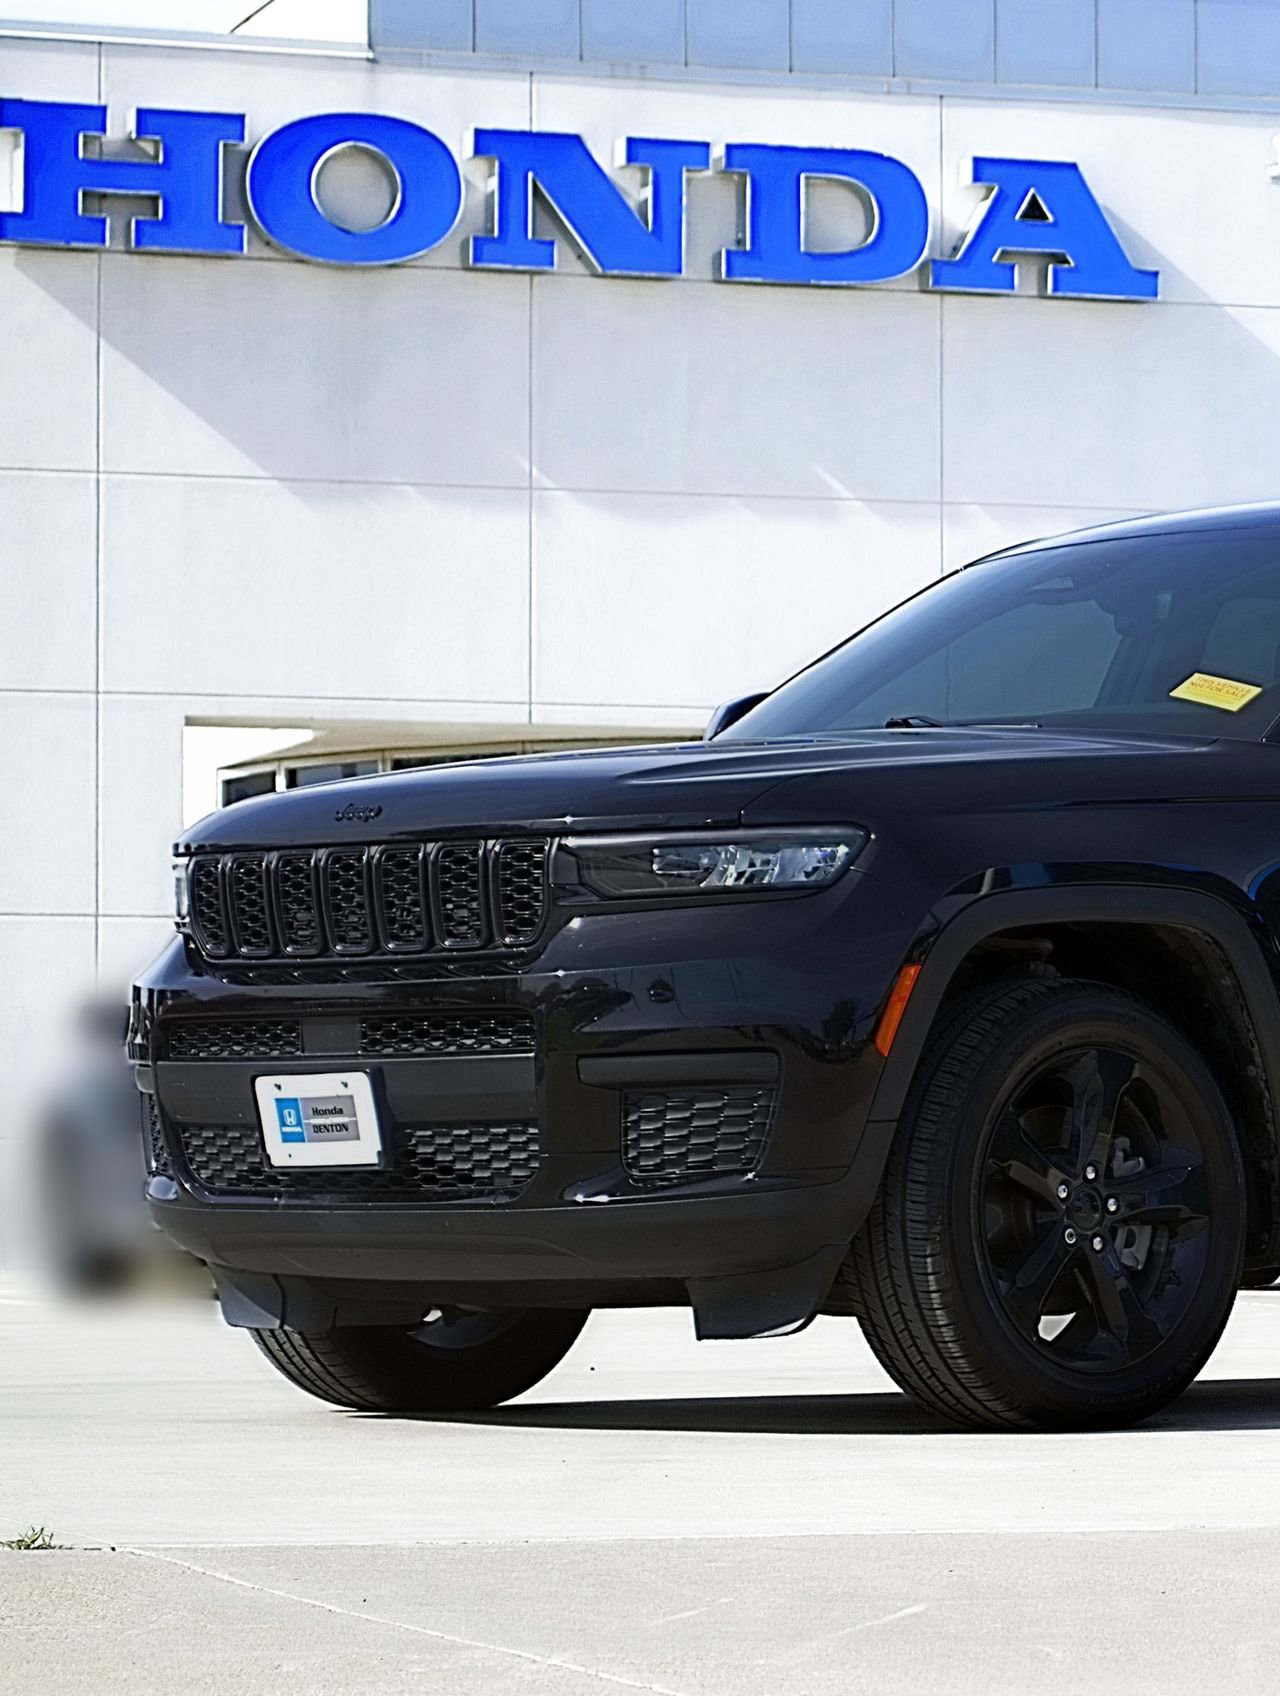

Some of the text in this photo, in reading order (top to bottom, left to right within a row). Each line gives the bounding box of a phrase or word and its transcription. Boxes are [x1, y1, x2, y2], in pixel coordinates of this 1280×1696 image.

[0, 98, 1161, 302] HONDA
[334, 802, 383, 823] Jeep
[312, 1106, 344, 1116] Honda
[312, 1123, 349, 1133] DENTON
